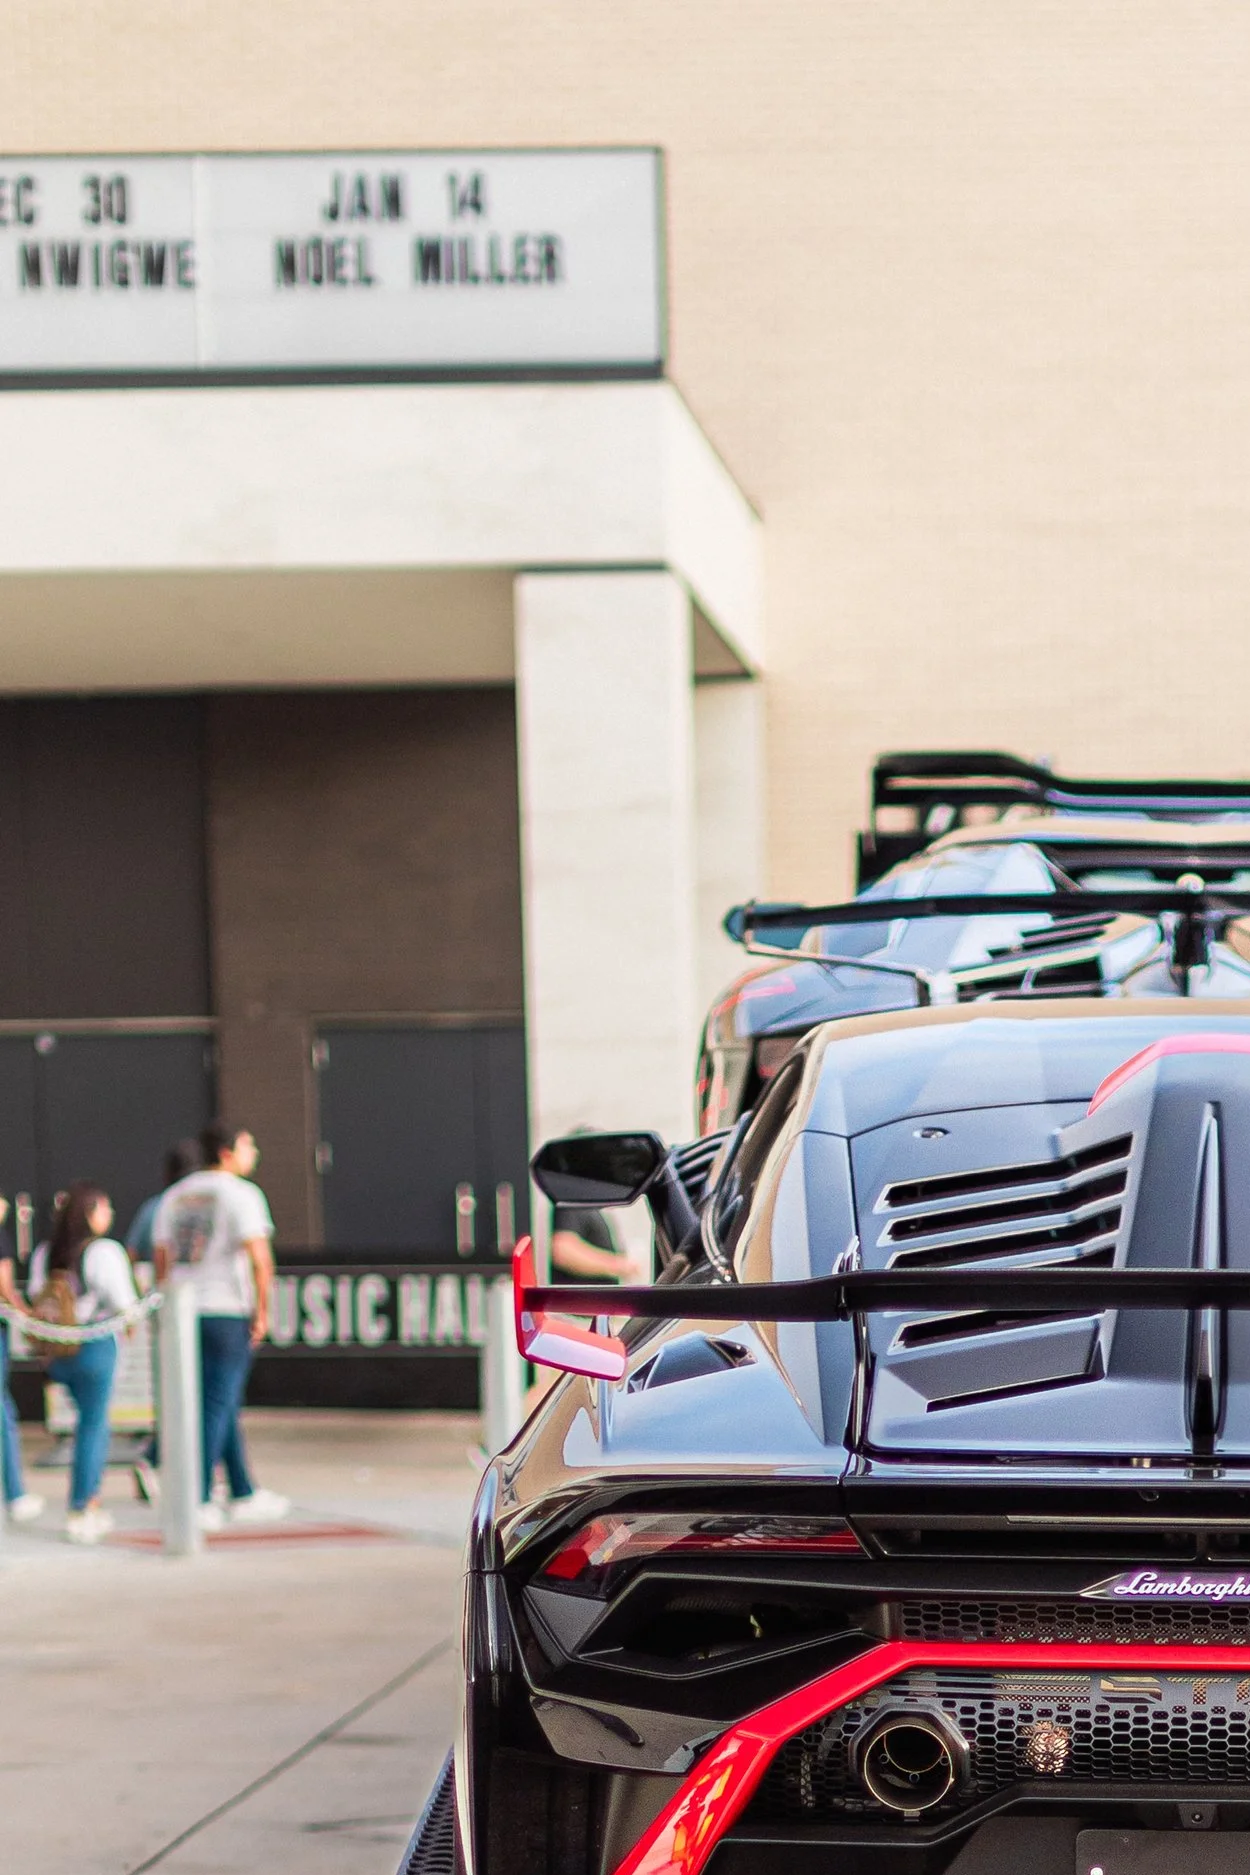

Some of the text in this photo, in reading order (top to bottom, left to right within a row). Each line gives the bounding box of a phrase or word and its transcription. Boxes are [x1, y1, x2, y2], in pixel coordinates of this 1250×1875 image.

[83, 175, 128, 225] 30
[322, 171, 482, 221] JAN 14
[20, 239, 195, 288] NWIGWE
[276, 234, 559, 284] NOEL MILLER
[269, 1273, 487, 1346] USIC HAL
